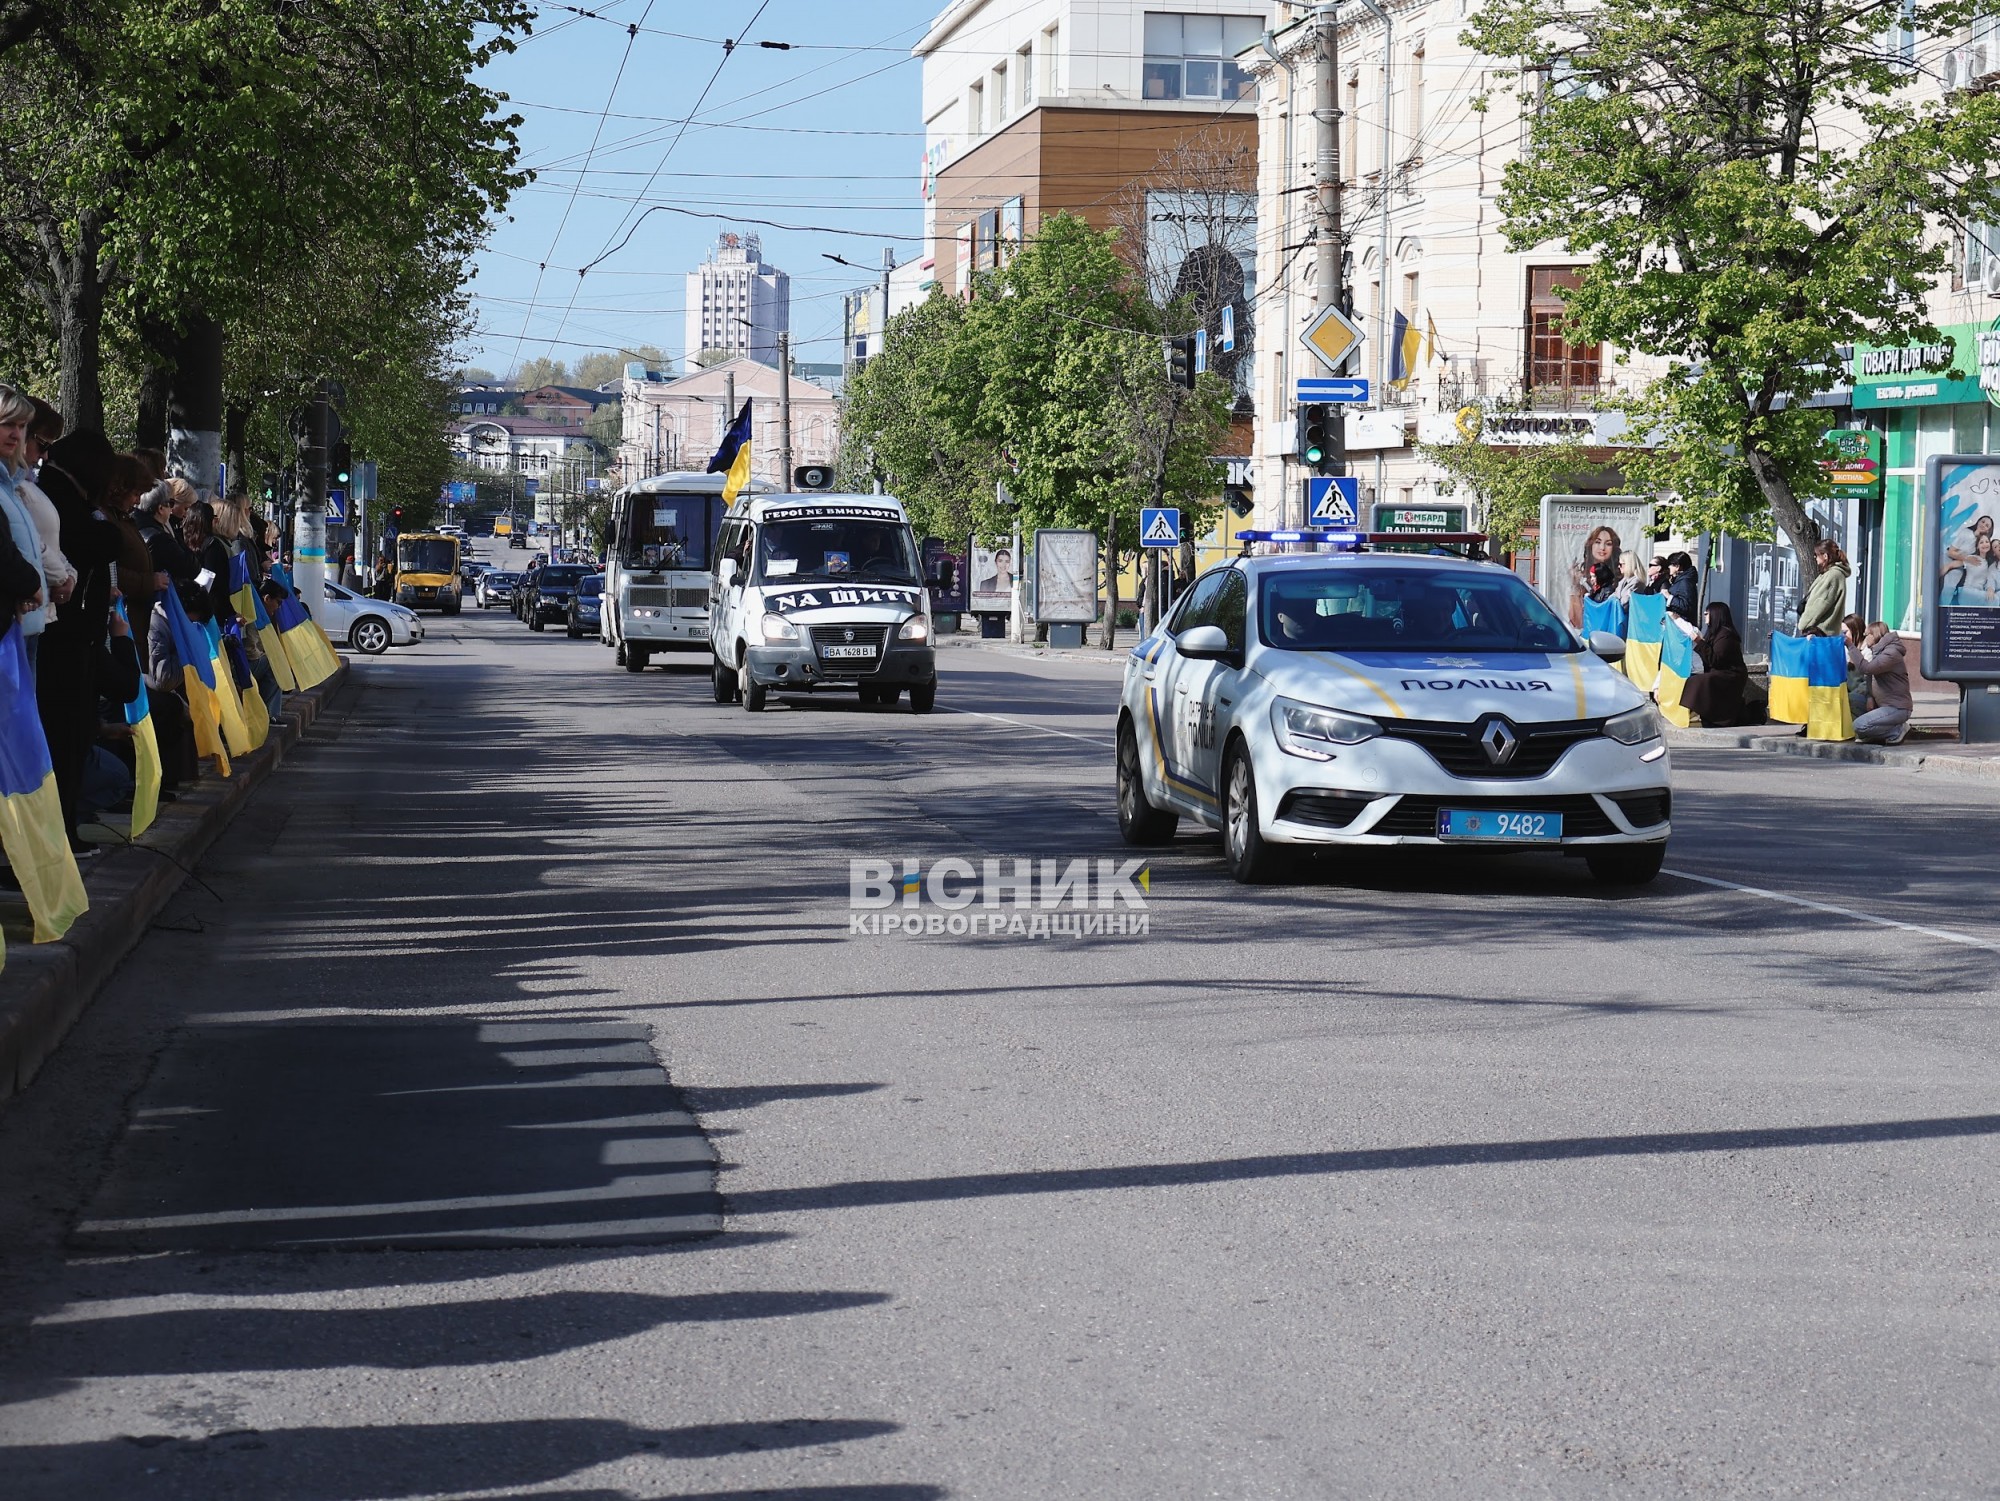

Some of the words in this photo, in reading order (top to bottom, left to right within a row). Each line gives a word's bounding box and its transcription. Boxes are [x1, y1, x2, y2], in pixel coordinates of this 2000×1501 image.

[1861, 350, 1899, 375] ТОВАРИ
[827, 507, 899, 519] ВМИРАЮТЬ
[1558, 505, 1597, 513] ЛАЗЕРНА
[1600, 506, 1641, 515] ЕПІЛЯЦІЯ
[844, 648, 861, 656] 1628
[1400, 679, 1553, 692] ПОЛІЦІЯ
[1440, 824, 1451, 833] 11
[1497, 814, 1546, 836] 9482
